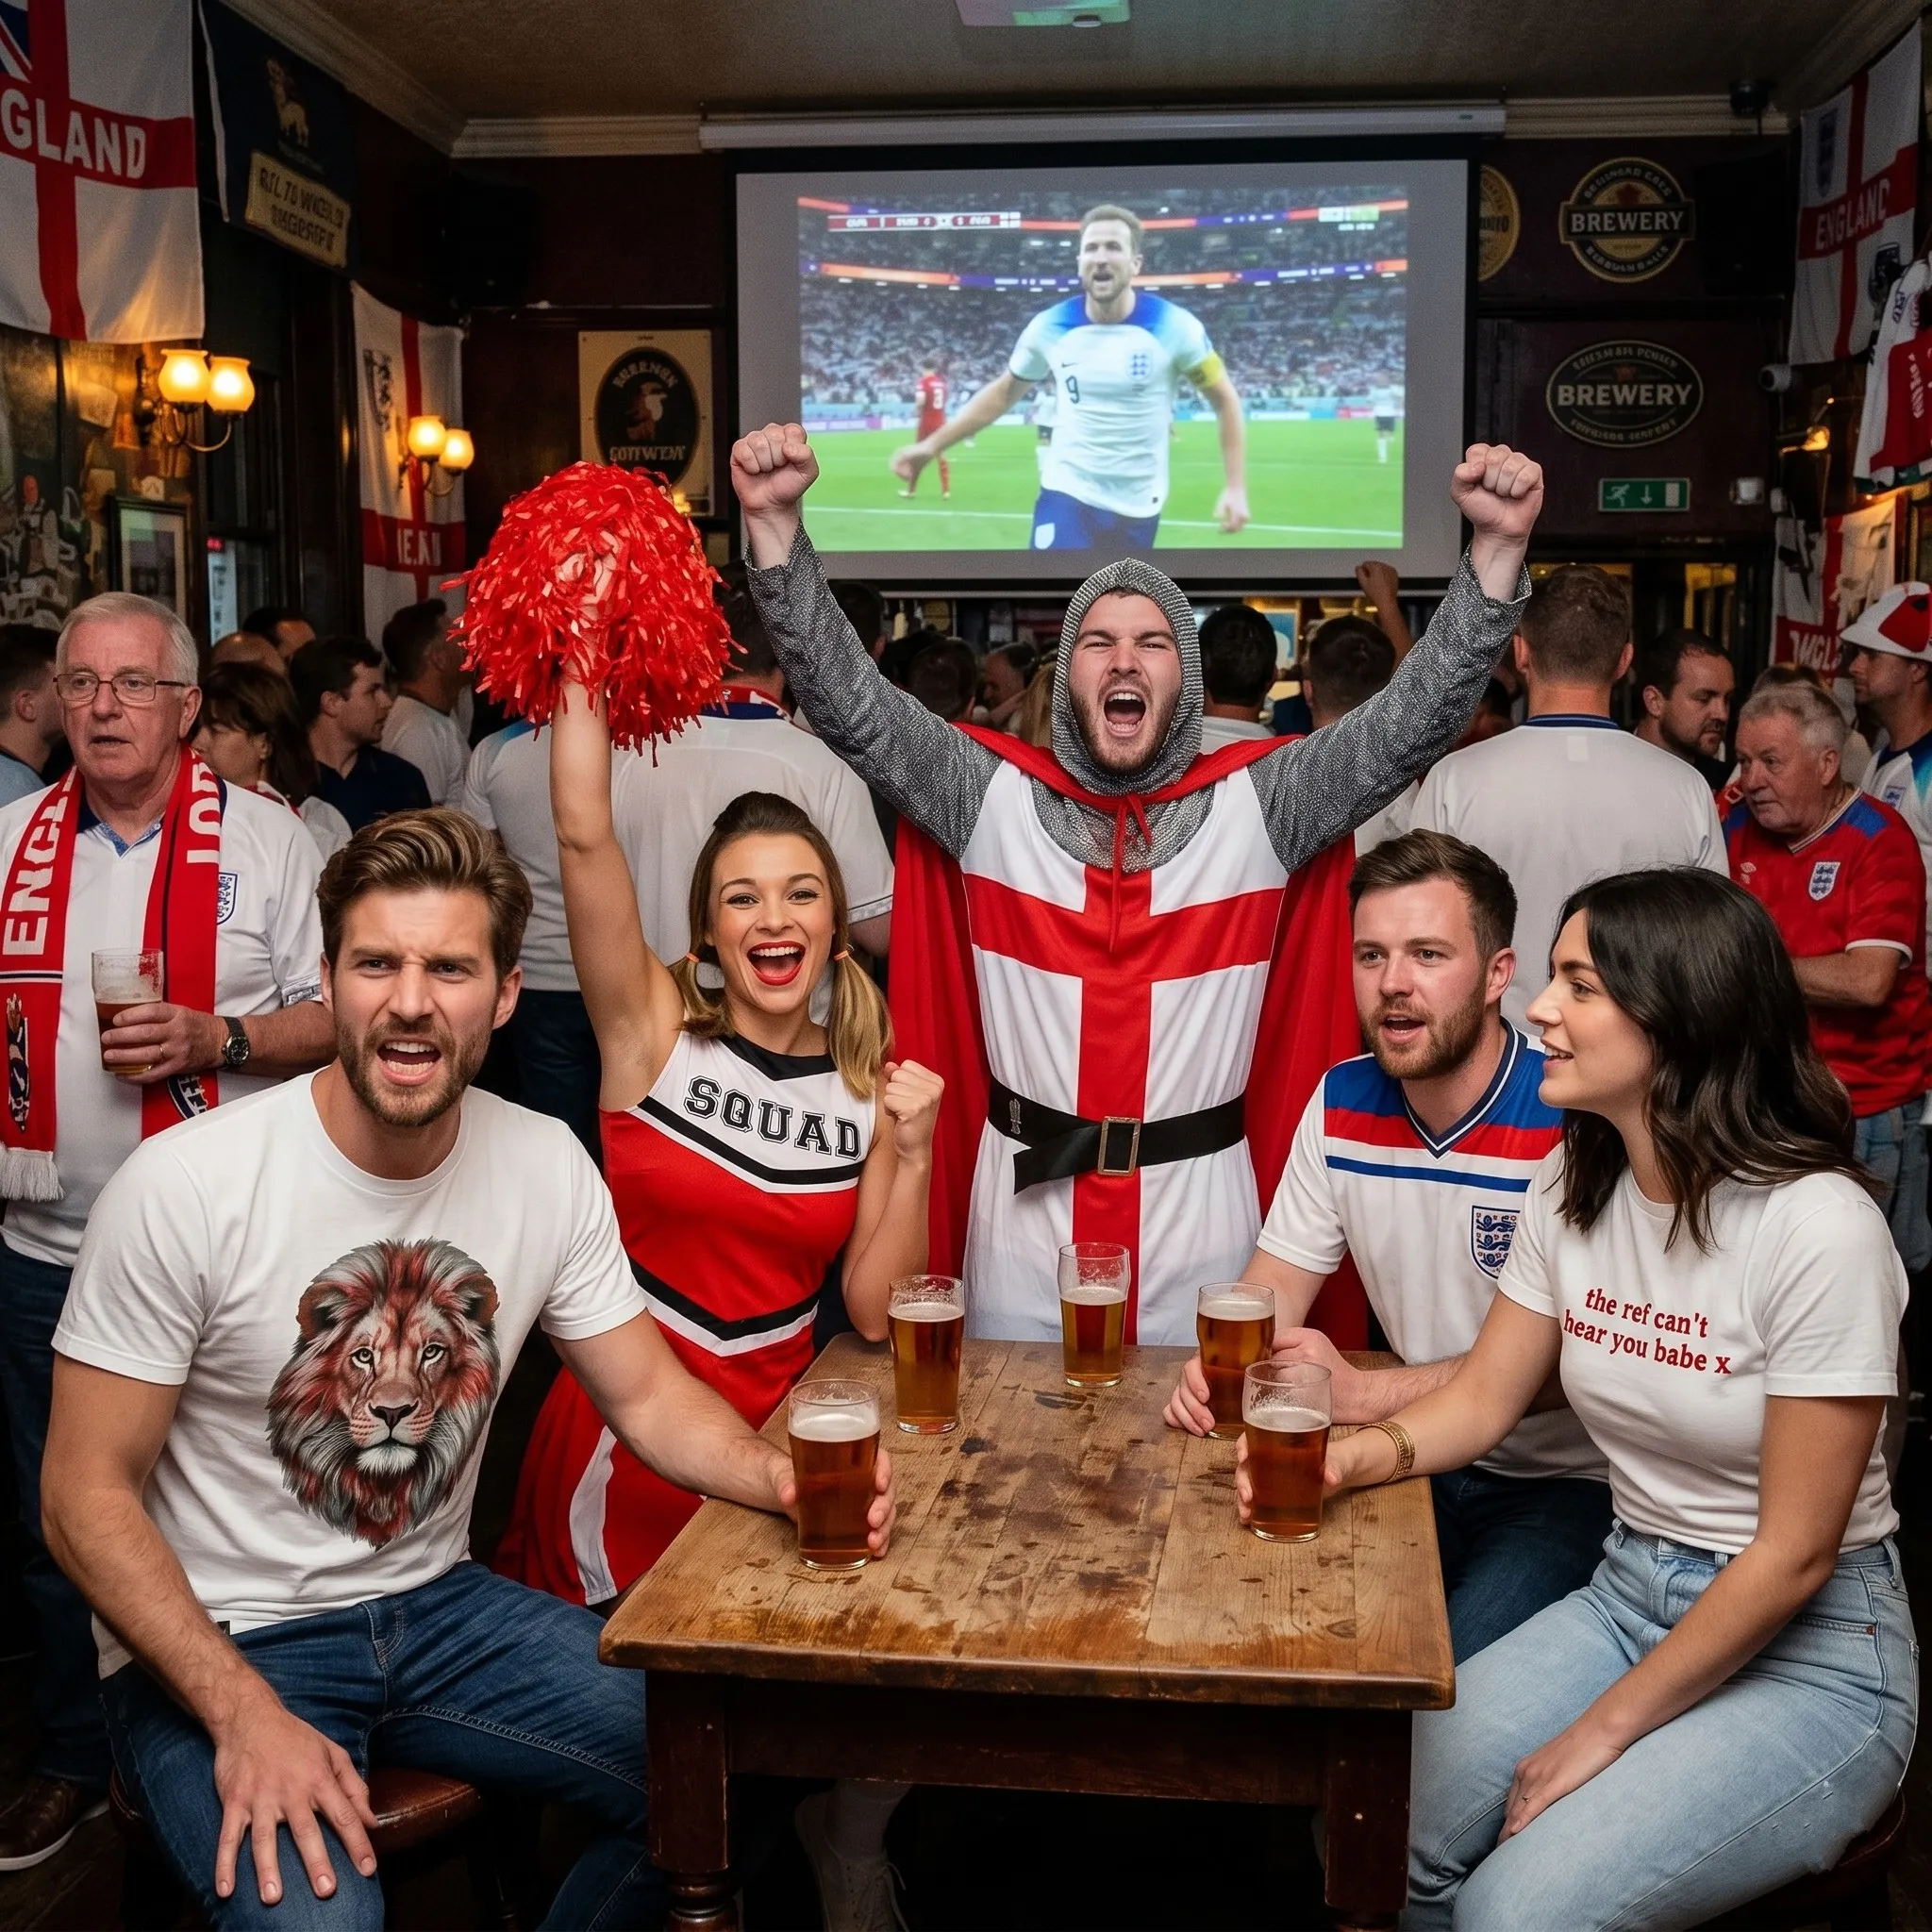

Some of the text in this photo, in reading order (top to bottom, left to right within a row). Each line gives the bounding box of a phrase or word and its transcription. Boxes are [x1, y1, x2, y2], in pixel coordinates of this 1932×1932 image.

[1571, 210, 1684, 233] BREWERY
[1065, 375, 1080, 405] 9
[1557, 383, 1693, 407] BREWERY
[683, 1074, 862, 1160] SQUAD
[1585, 1288, 1708, 1338] the ref can't
[1563, 1308, 1732, 1374] hear you babe x
